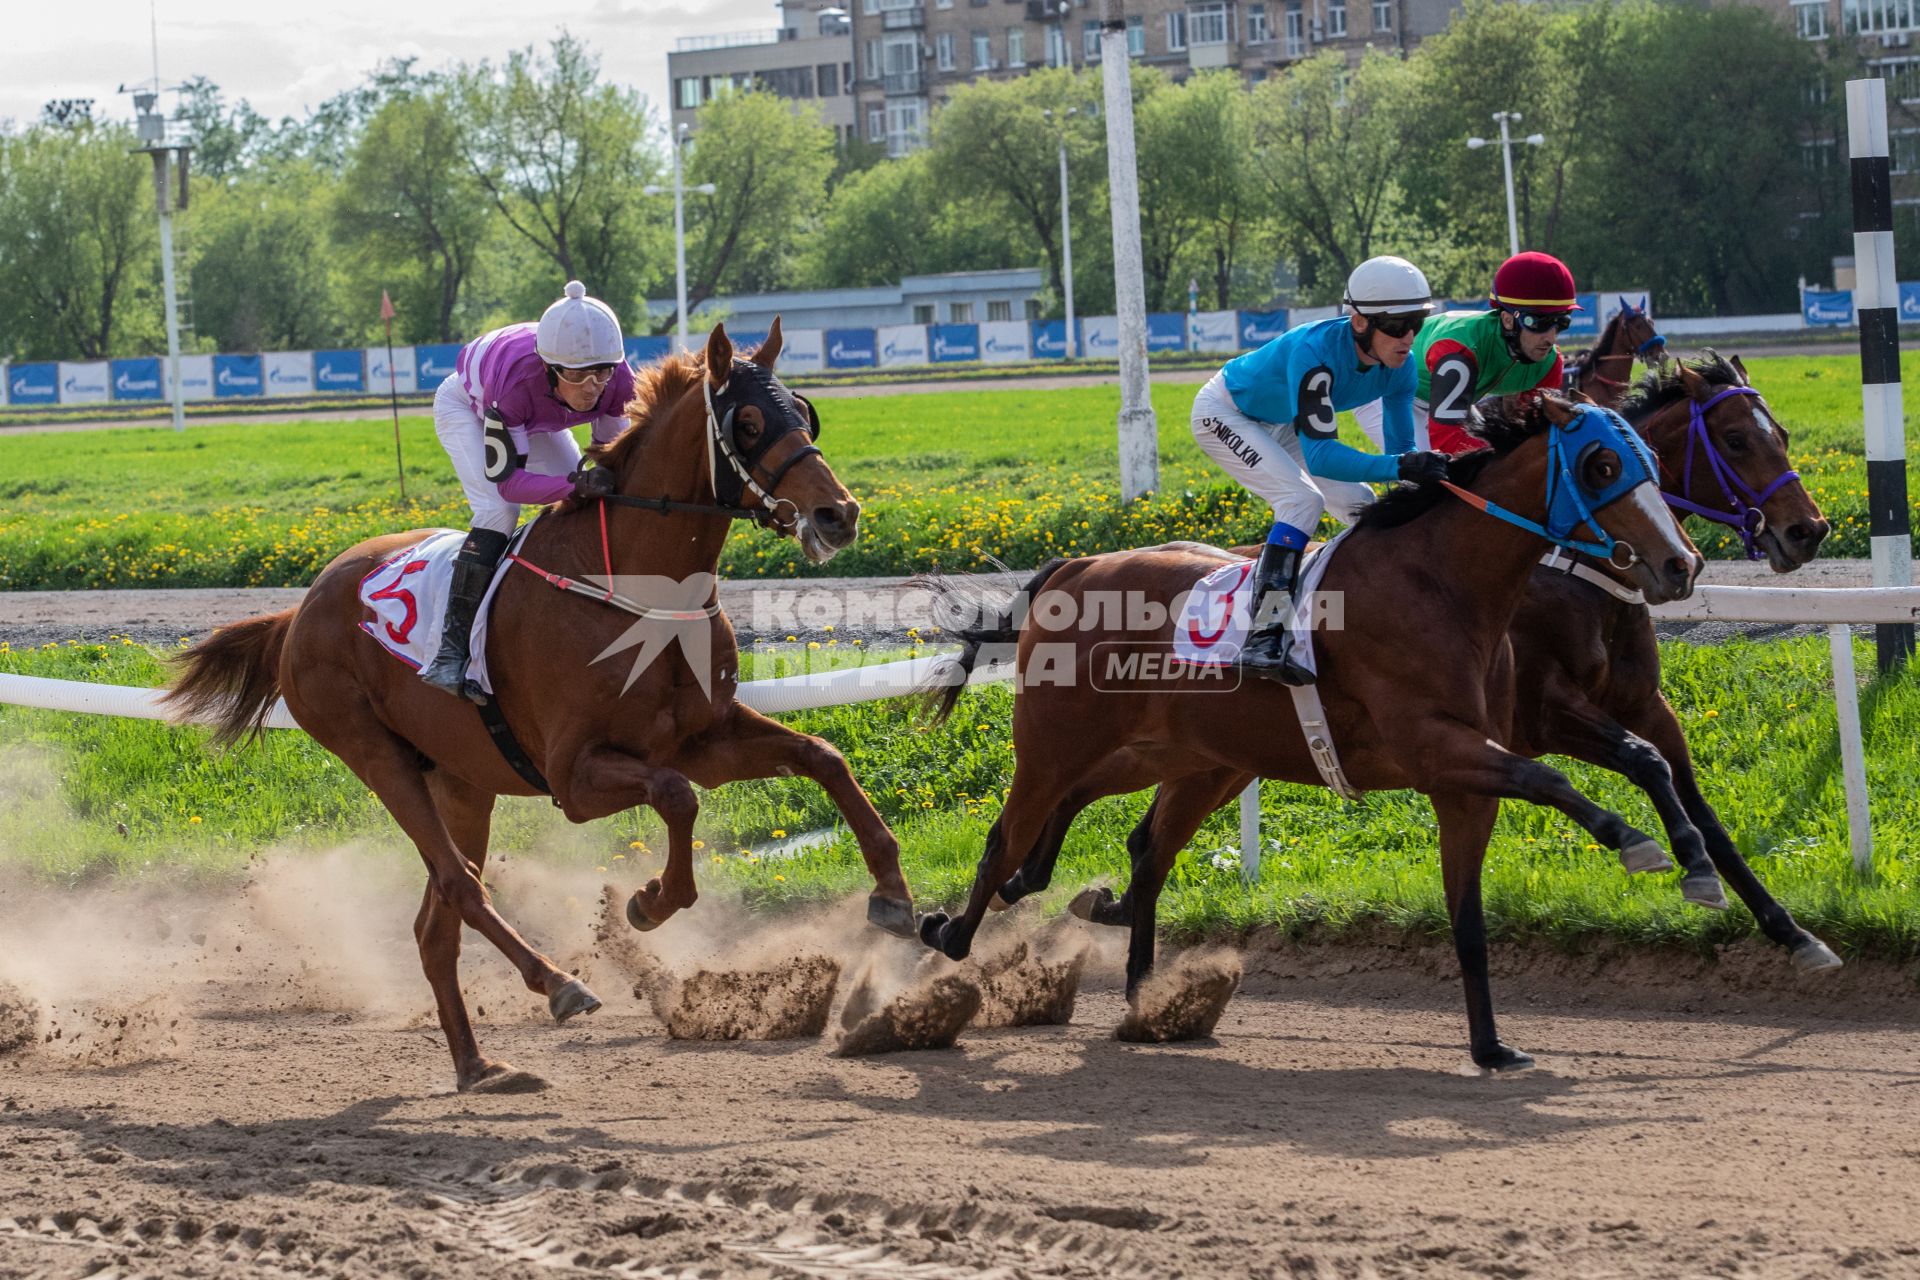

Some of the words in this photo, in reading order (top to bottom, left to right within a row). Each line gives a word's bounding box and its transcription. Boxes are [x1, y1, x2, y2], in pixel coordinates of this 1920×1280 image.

[1307, 372, 1338, 433] 3
[1434, 360, 1470, 419] 2
[484, 418, 508, 478] 5
[368, 560, 430, 644] 5
